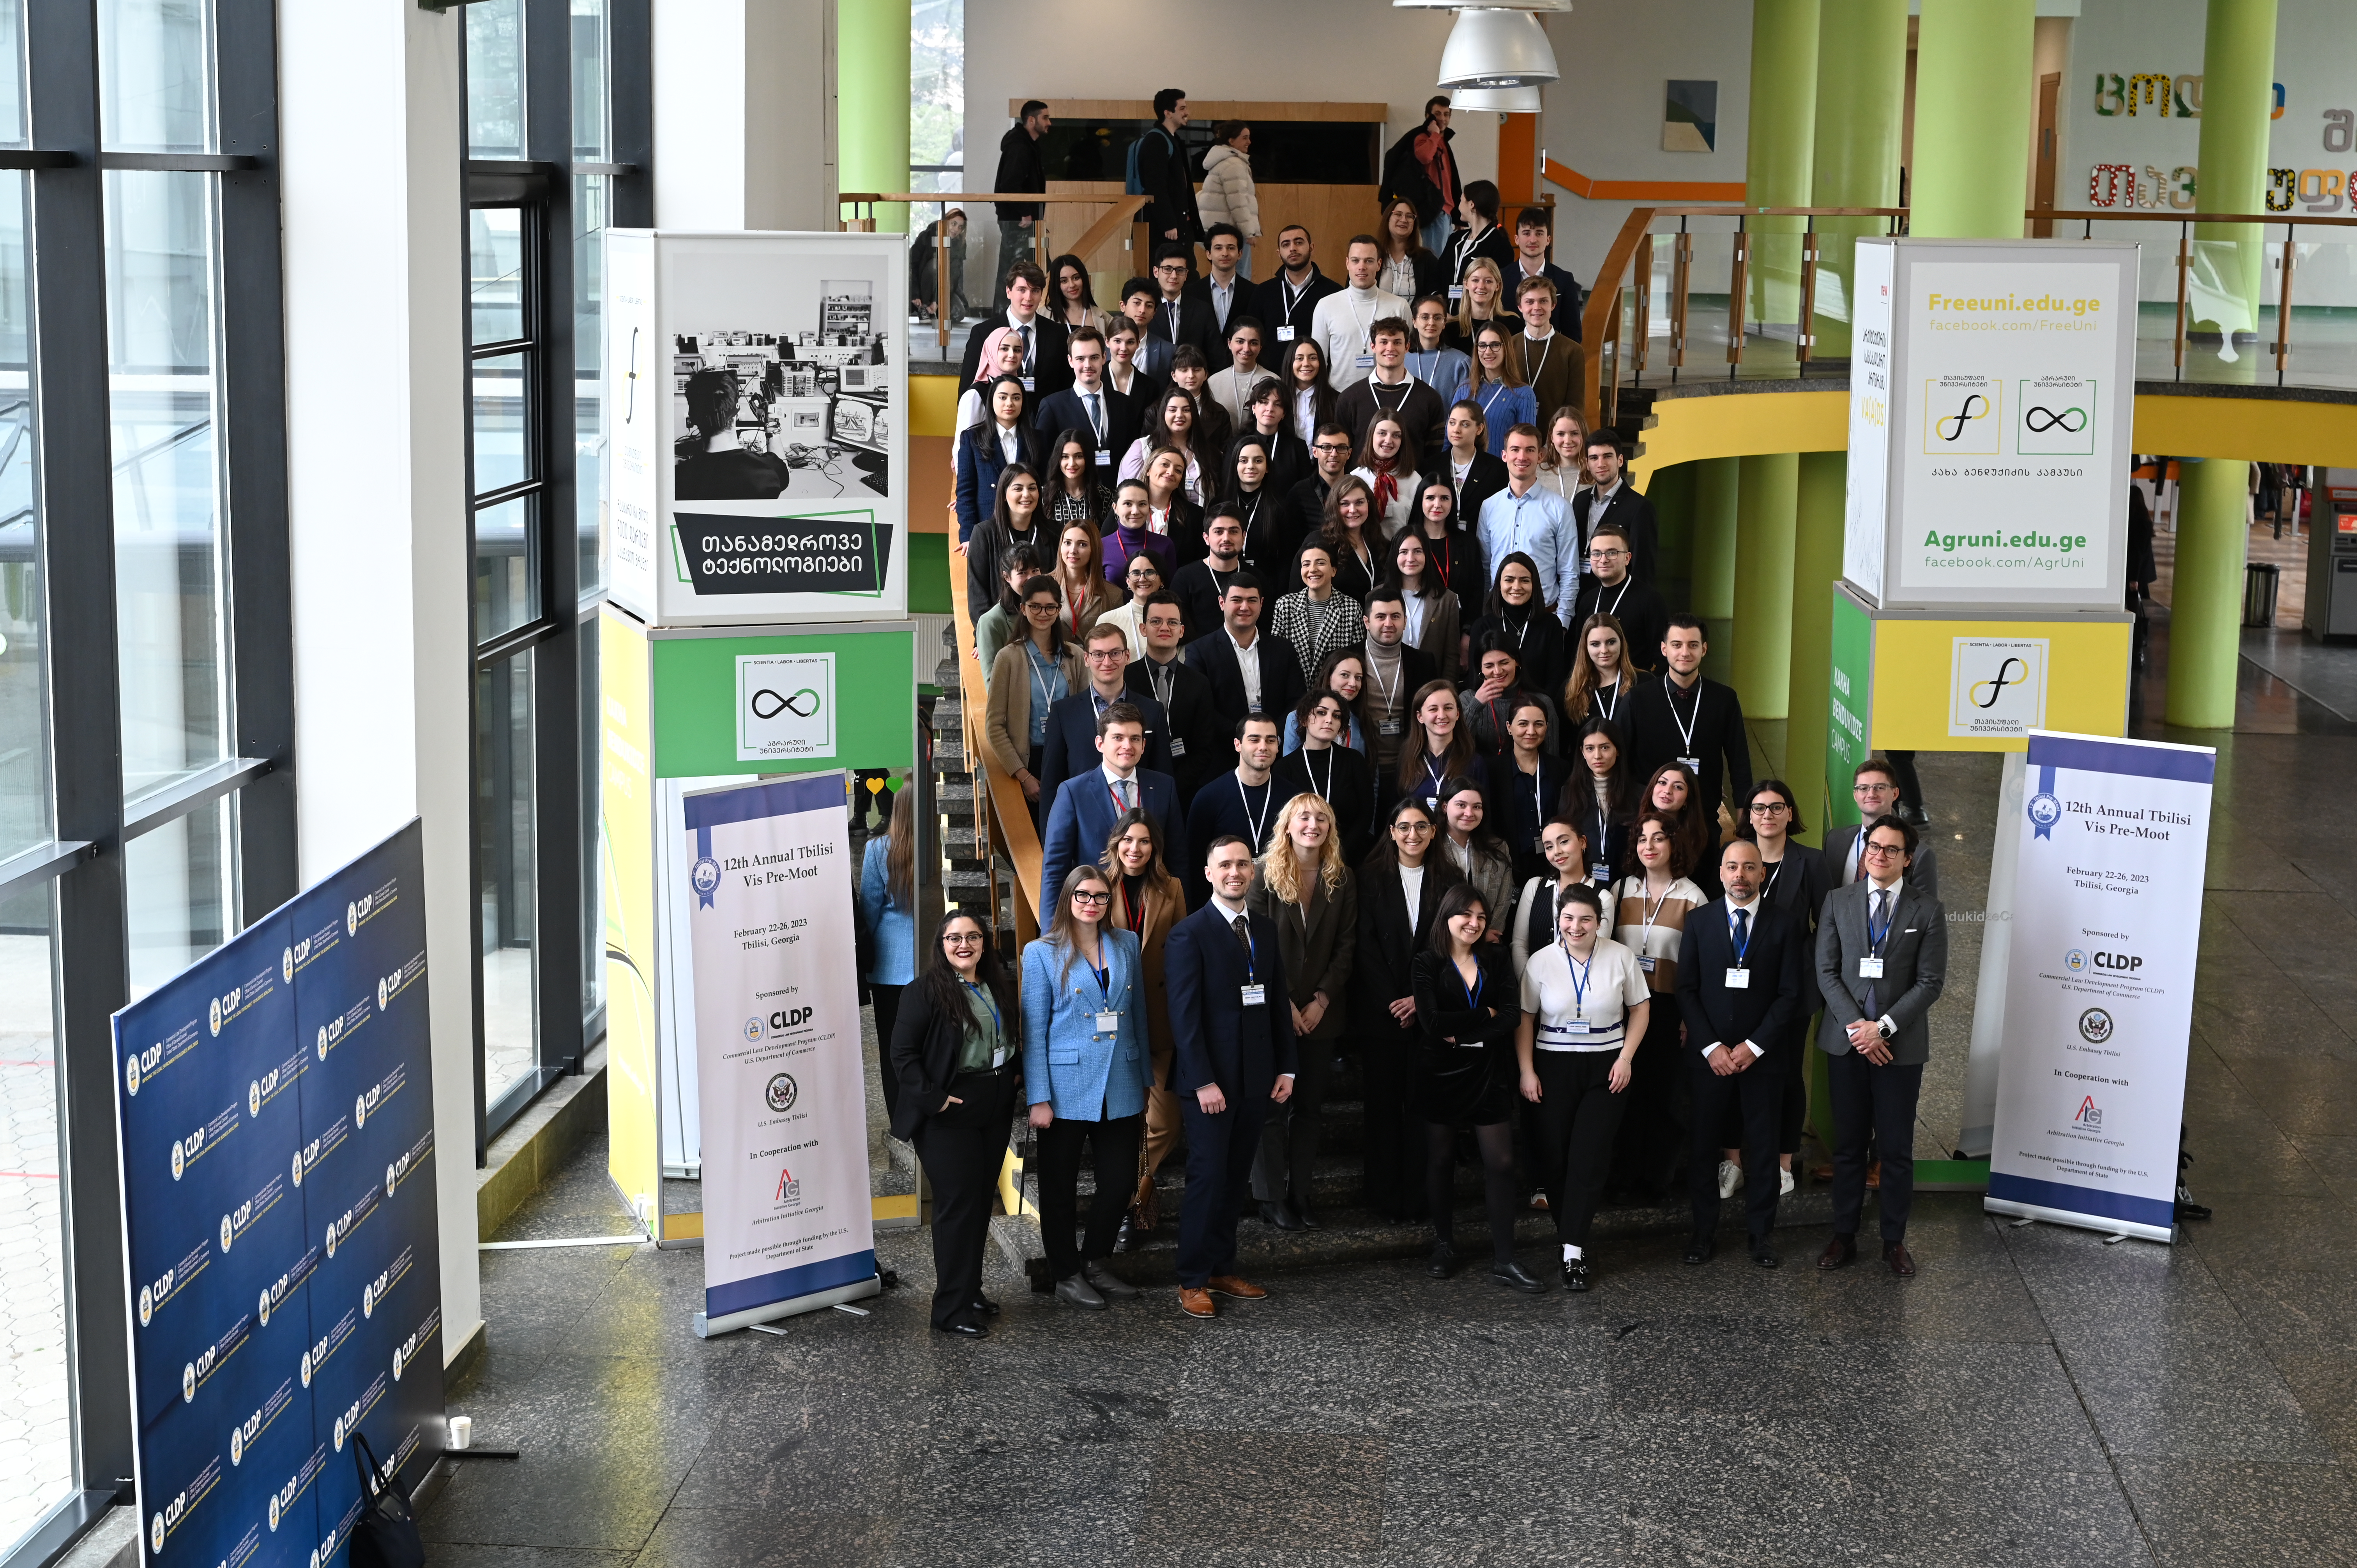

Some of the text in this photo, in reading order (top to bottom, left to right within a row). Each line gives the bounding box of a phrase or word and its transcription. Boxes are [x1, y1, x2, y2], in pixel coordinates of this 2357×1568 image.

[1929, 293, 2100, 316] Freeuni.edu.ge
[1930, 320, 2096, 331] facebook.com/FreeUni
[702, 534, 862, 553] თანამედროვე
[1924, 530, 2086, 553] Agruni.edu.ge
[702, 556, 862, 575] ტექნოლოგიები
[1925, 556, 2083, 570] facebook.com/AgrUni
[1834, 666, 1850, 698] KAKHA
[1832, 697, 1862, 743] BENDUKIDZE
[1831, 728, 1850, 764] CAMPUS
[2066, 801, 2191, 825] 12th Annual Tbilisi
[2085, 821, 2170, 841] Vis Pre-Moot
[724, 842, 833, 871] 12th Annual Tbilisi
[743, 865, 818, 887] Vis Pre-Moot
[2067, 866, 2149, 883] February 22-26, 2023
[2074, 879, 2138, 895] Tbilisi, Georgia
[358, 894, 373, 918] CLDP
[734, 918, 807, 938] February 22-26, 2023
[2082, 928, 2118, 938] Sponsored
[742, 934, 799, 950] Tbilisi, Georgia
[2094, 952, 2142, 971] CLDP
[388, 969, 401, 992] CLDP
[2039, 973, 2070, 982] Commercial
[2084, 978, 2118, 988] Development
[223, 987, 241, 1015] CLDP
[756, 986, 798, 1000] Sponsored by
[2073, 985, 2105, 995] Department
[2112, 991, 2141, 1000] Commerce
[770, 1006, 813, 1029] CLDP
[723, 1049, 751, 1059] Commercial
[765, 1041, 796, 1051] Development
[818, 1033, 836, 1041] (CLDP)
[756, 1052, 784, 1063] Department
[792, 1047, 815, 1055] Commerce
[2079, 1046, 2102, 1055] Embassy
[141, 1043, 163, 1072] CLDP
[261, 1068, 279, 1096] CLDP
[2065, 1071, 2109, 1083] Cooperation
[366, 1084, 380, 1108] CLDP
[792, 1112, 807, 1120] Tbilisi
[186, 1127, 205, 1157] CLDP
[760, 1144, 801, 1157] Cooperation
[803, 1139, 818, 1148] with
[2046, 1130, 2124, 1147] Arbitration Initiative Georgia
[396, 1152, 409, 1178] CLDP
[2053, 1157, 2075, 1165] possible
[2076, 1161, 2096, 1169] through
[2097, 1164, 2119, 1174] funding
[2057, 1165, 2087, 1175] Department
[233, 1200, 251, 1230] CLDP
[752, 1205, 823, 1225] Arbitration Initiative Georgia
[762, 1243, 781, 1254] possible
[783, 1238, 802, 1247] through
[802, 1234, 822, 1243] funding
[766, 1249, 794, 1260] Department
[154, 1269, 174, 1301] CLDP
[374, 1271, 387, 1296] CLDP
[403, 1333, 415, 1360] CLDP
[197, 1346, 215, 1376] CLDP
[244, 1409, 261, 1440] CLDP
[166, 1492, 185, 1526] CLDP
[321, 1530, 336, 1561] CLDP
